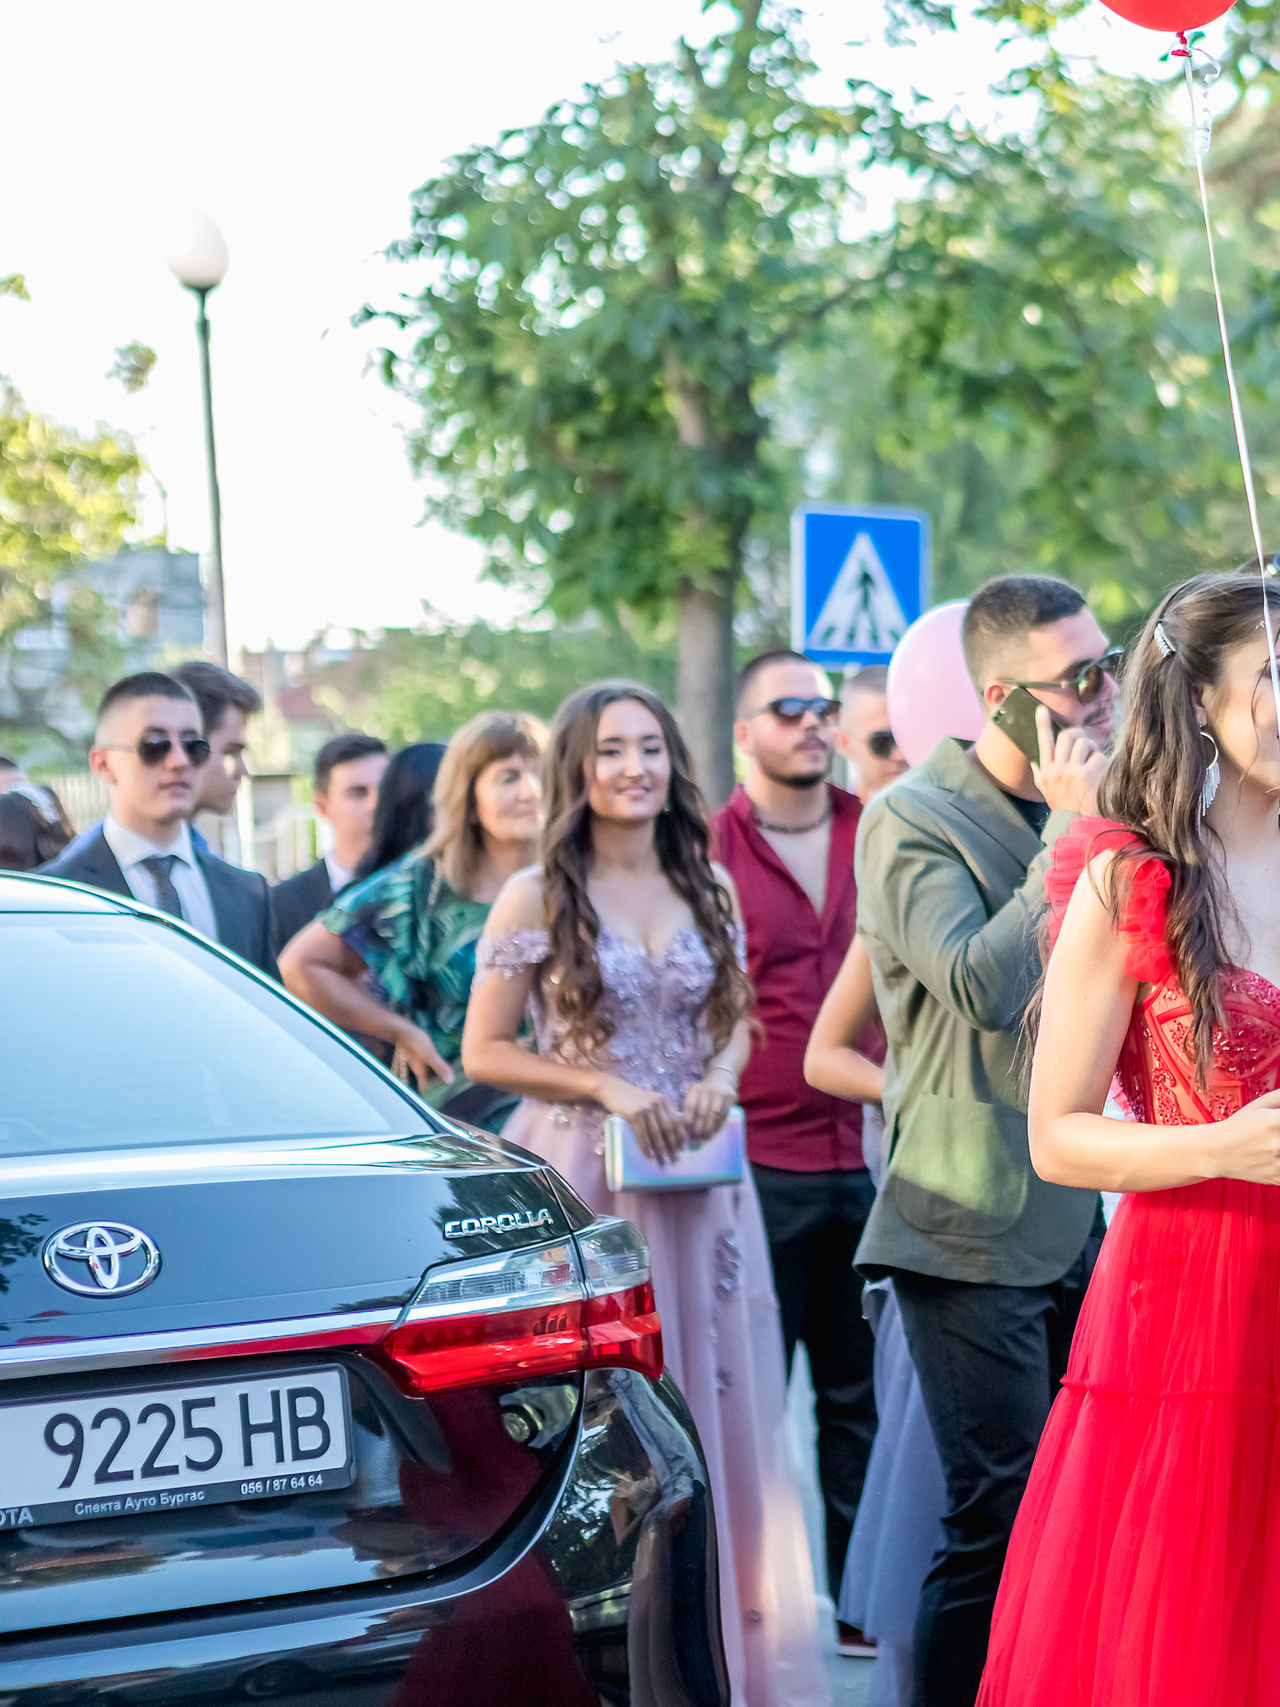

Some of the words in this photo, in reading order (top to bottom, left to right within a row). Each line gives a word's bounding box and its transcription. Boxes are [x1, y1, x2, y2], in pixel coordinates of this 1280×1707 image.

[444, 1208, 554, 1239] COROLLA
[44, 1396, 223, 1489] 9225
[239, 1387, 331, 1467] HB
[240, 1481, 263, 1495] 056
[273, 1478, 287, 1491] 87
[290, 1476, 305, 1489] 64
[308, 1474, 323, 1487] 64
[74, 1501, 121, 1515] Спекта
[124, 1497, 157, 1511] Ауто
[160, 1490, 205, 1507] Бургас
